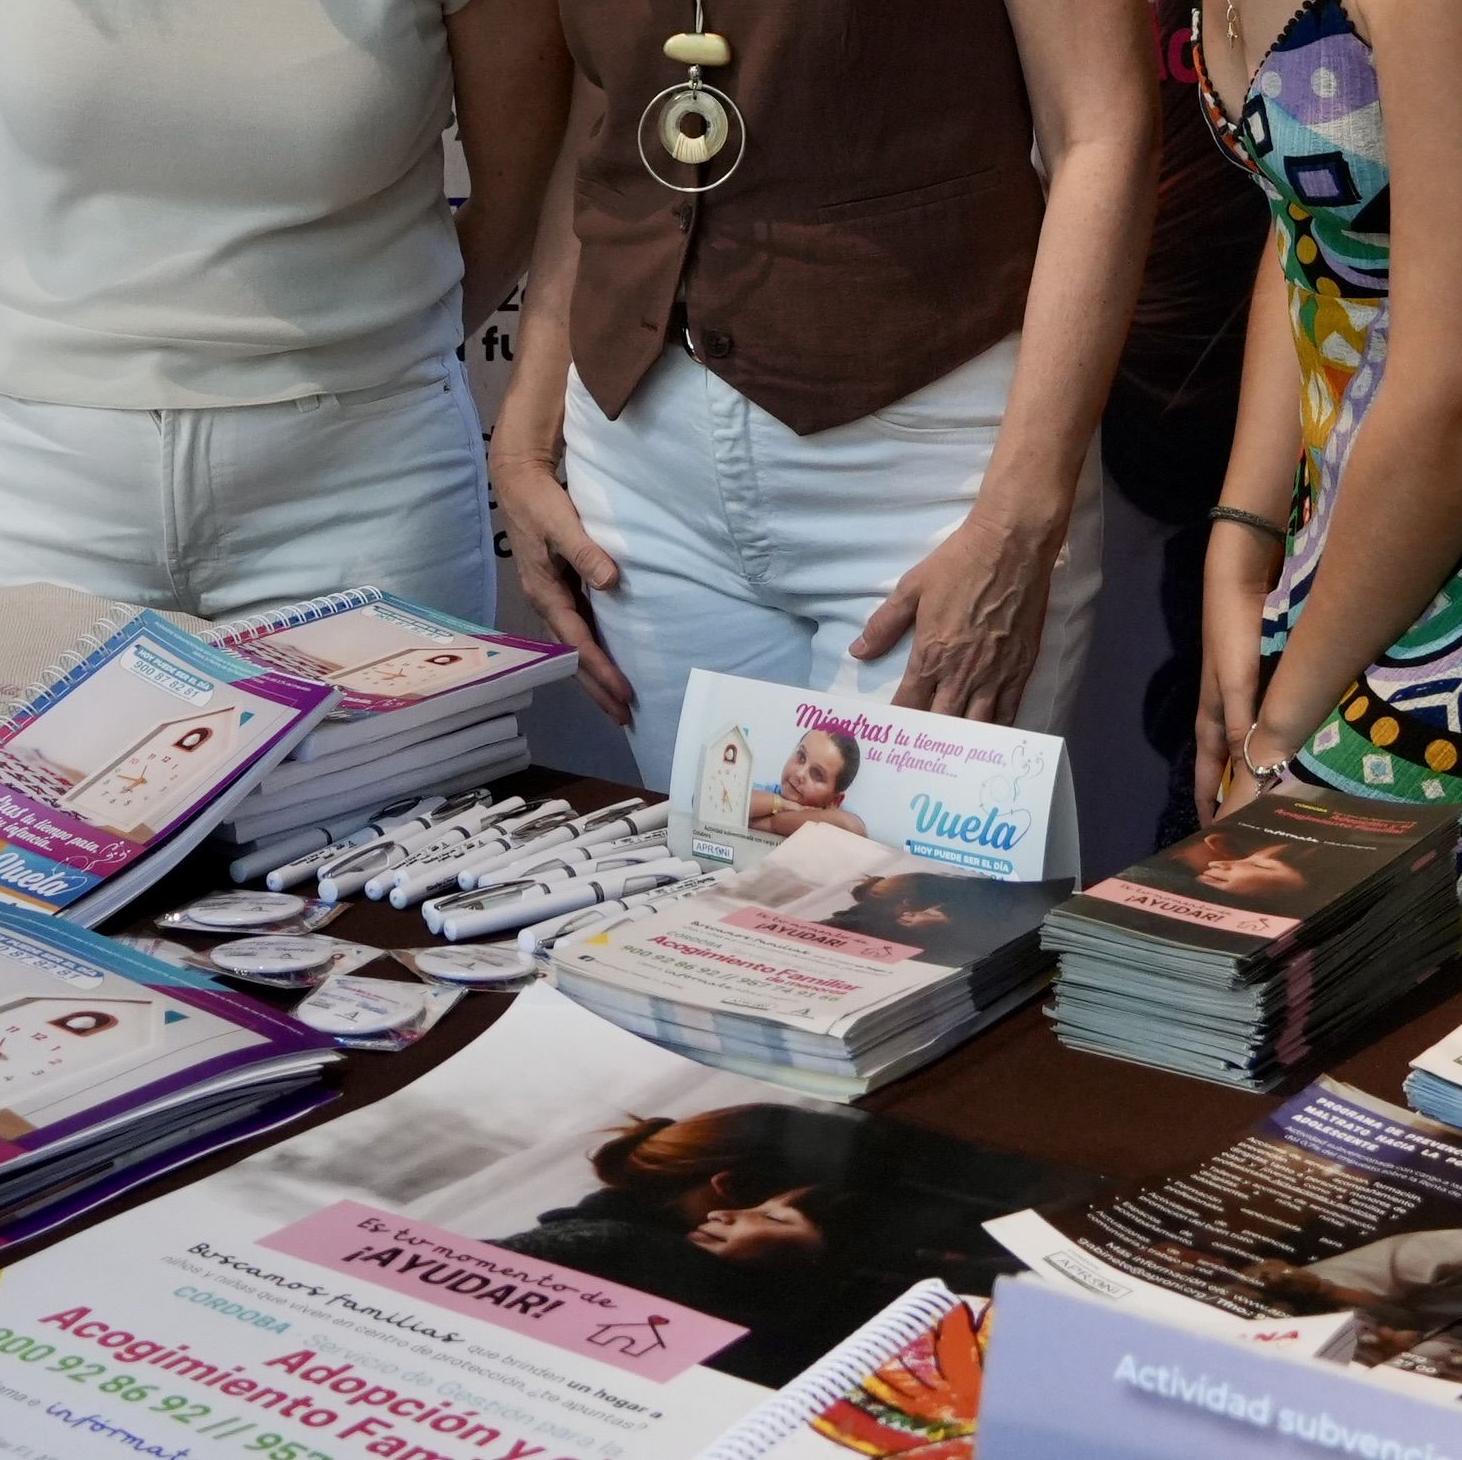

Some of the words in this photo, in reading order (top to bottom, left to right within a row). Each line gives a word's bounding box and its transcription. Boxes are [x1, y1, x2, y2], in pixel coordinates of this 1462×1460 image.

[795, 702, 893, 744] Mientras
[893, 727, 911, 747] tu
[913, 732, 964, 759] tiempo
[866, 746, 883, 762] su
[34, 817, 74, 843] tiempo
[909, 793, 1018, 852] Vuela
[913, 843, 934, 856] HOY
[934, 848, 962, 863] PUEDE
[963, 855, 982, 867] SER
[981, 858, 993, 869] EL
[992, 858, 1010, 873] DÍA
[1124, 894, 1226, 923] ¡AYUDAR!
[648, 934, 777, 975] Acogimiento
[775, 966, 864, 992] Familiar
[340, 1245, 567, 1320] ¡AYUDAR!
[357, 1216, 390, 1233] Es
[431, 1244, 581, 1292] momento
[579, 1290, 618, 1309] de
[172, 1284, 293, 1336] CÓRDOBA
[186, 1241, 331, 1298] Buscamos
[325, 1292, 467, 1344] familias
[566, 1379, 593, 1394] un
[592, 1387, 649, 1415] hogar
[649, 1410, 664, 1420] a
[39, 1304, 339, 1429] Acogimiento
[45, 1354, 108, 1385] 92
[97, 1374, 160, 1403] 86
[147, 1393, 212, 1426] 92
[1113, 1352, 1273, 1428] Actividad
[263, 1348, 502, 1447] Adopción
